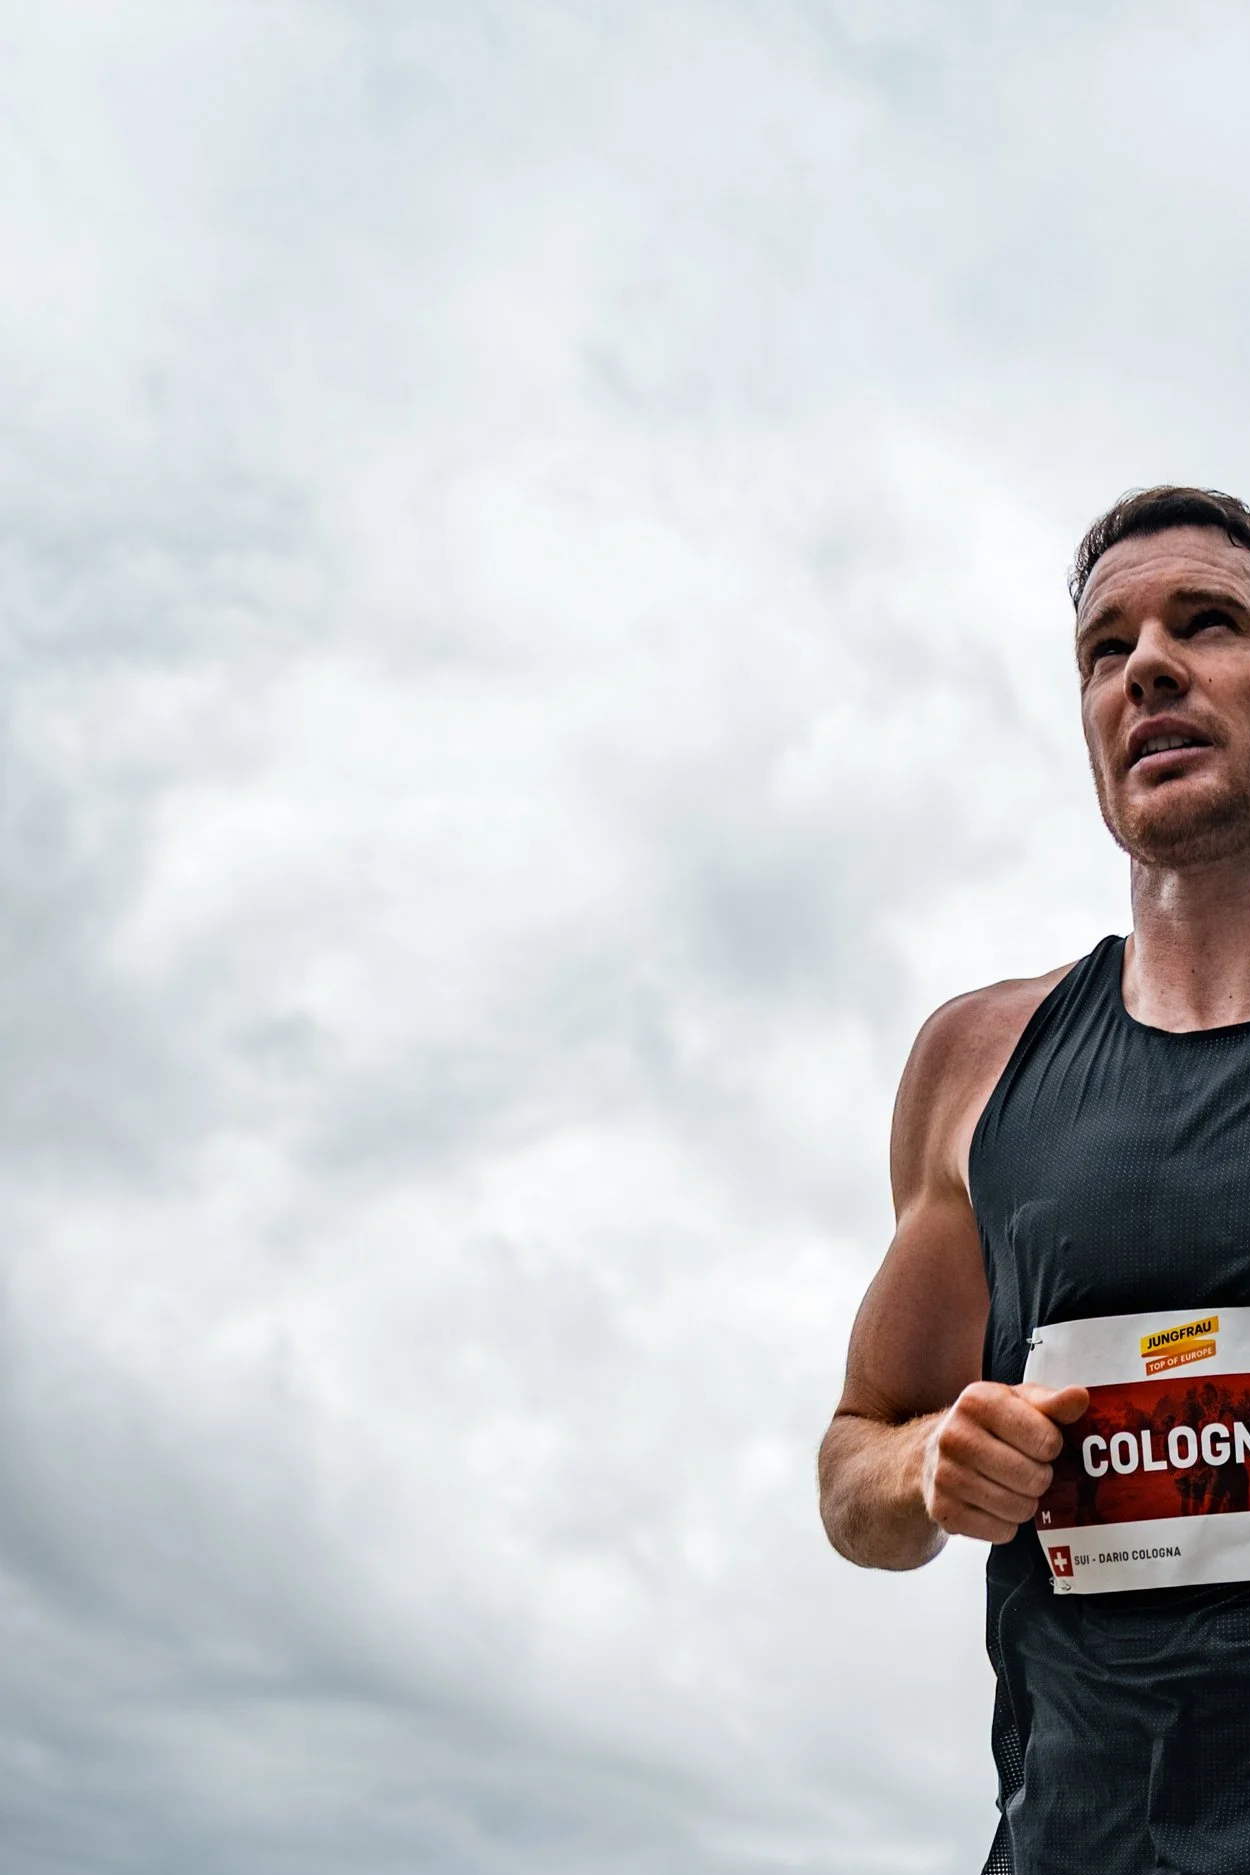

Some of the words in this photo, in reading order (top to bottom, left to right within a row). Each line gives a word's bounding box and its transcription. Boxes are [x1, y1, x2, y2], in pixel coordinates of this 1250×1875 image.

[1147, 1321, 1212, 1349] JUNGFRAU
[1149, 1361, 1166, 1372] TOP
[1167, 1357, 1179, 1366] OF
[1180, 1347, 1213, 1363] EUROPE
[1042, 1511, 1051, 1524] M
[1074, 1556, 1090, 1566] SUI
[1099, 1551, 1129, 1564] DARIO
[1132, 1546, 1182, 1560] COLOGNA
